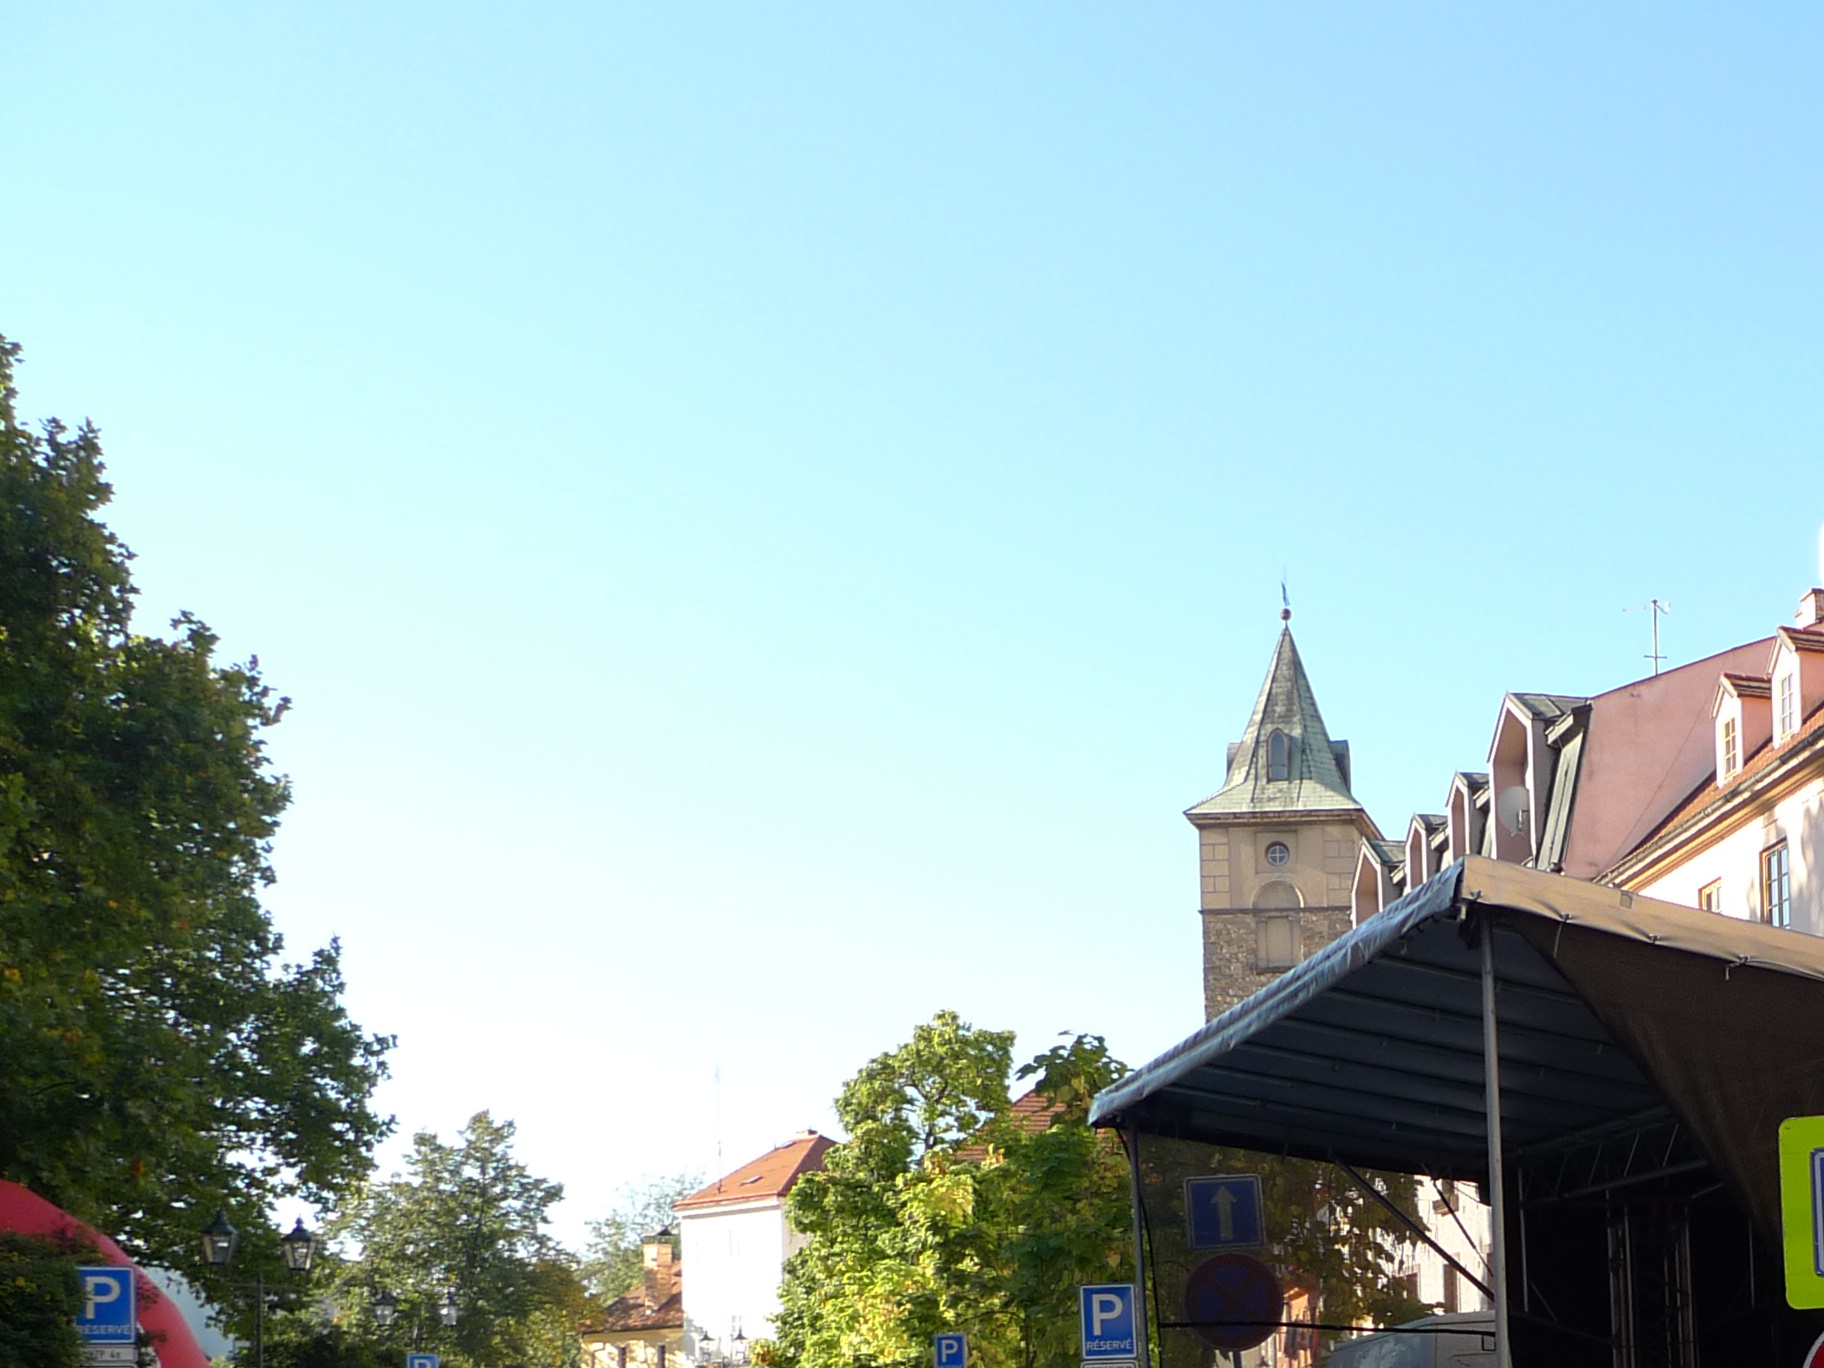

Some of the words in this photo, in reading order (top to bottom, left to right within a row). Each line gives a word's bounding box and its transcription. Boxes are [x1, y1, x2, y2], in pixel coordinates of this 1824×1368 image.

[85, 1276, 121, 1319] P
[1092, 1293, 1123, 1336] P
[941, 1339, 958, 1363] P
[1086, 1337, 1133, 1351] RÉSERVÉ
